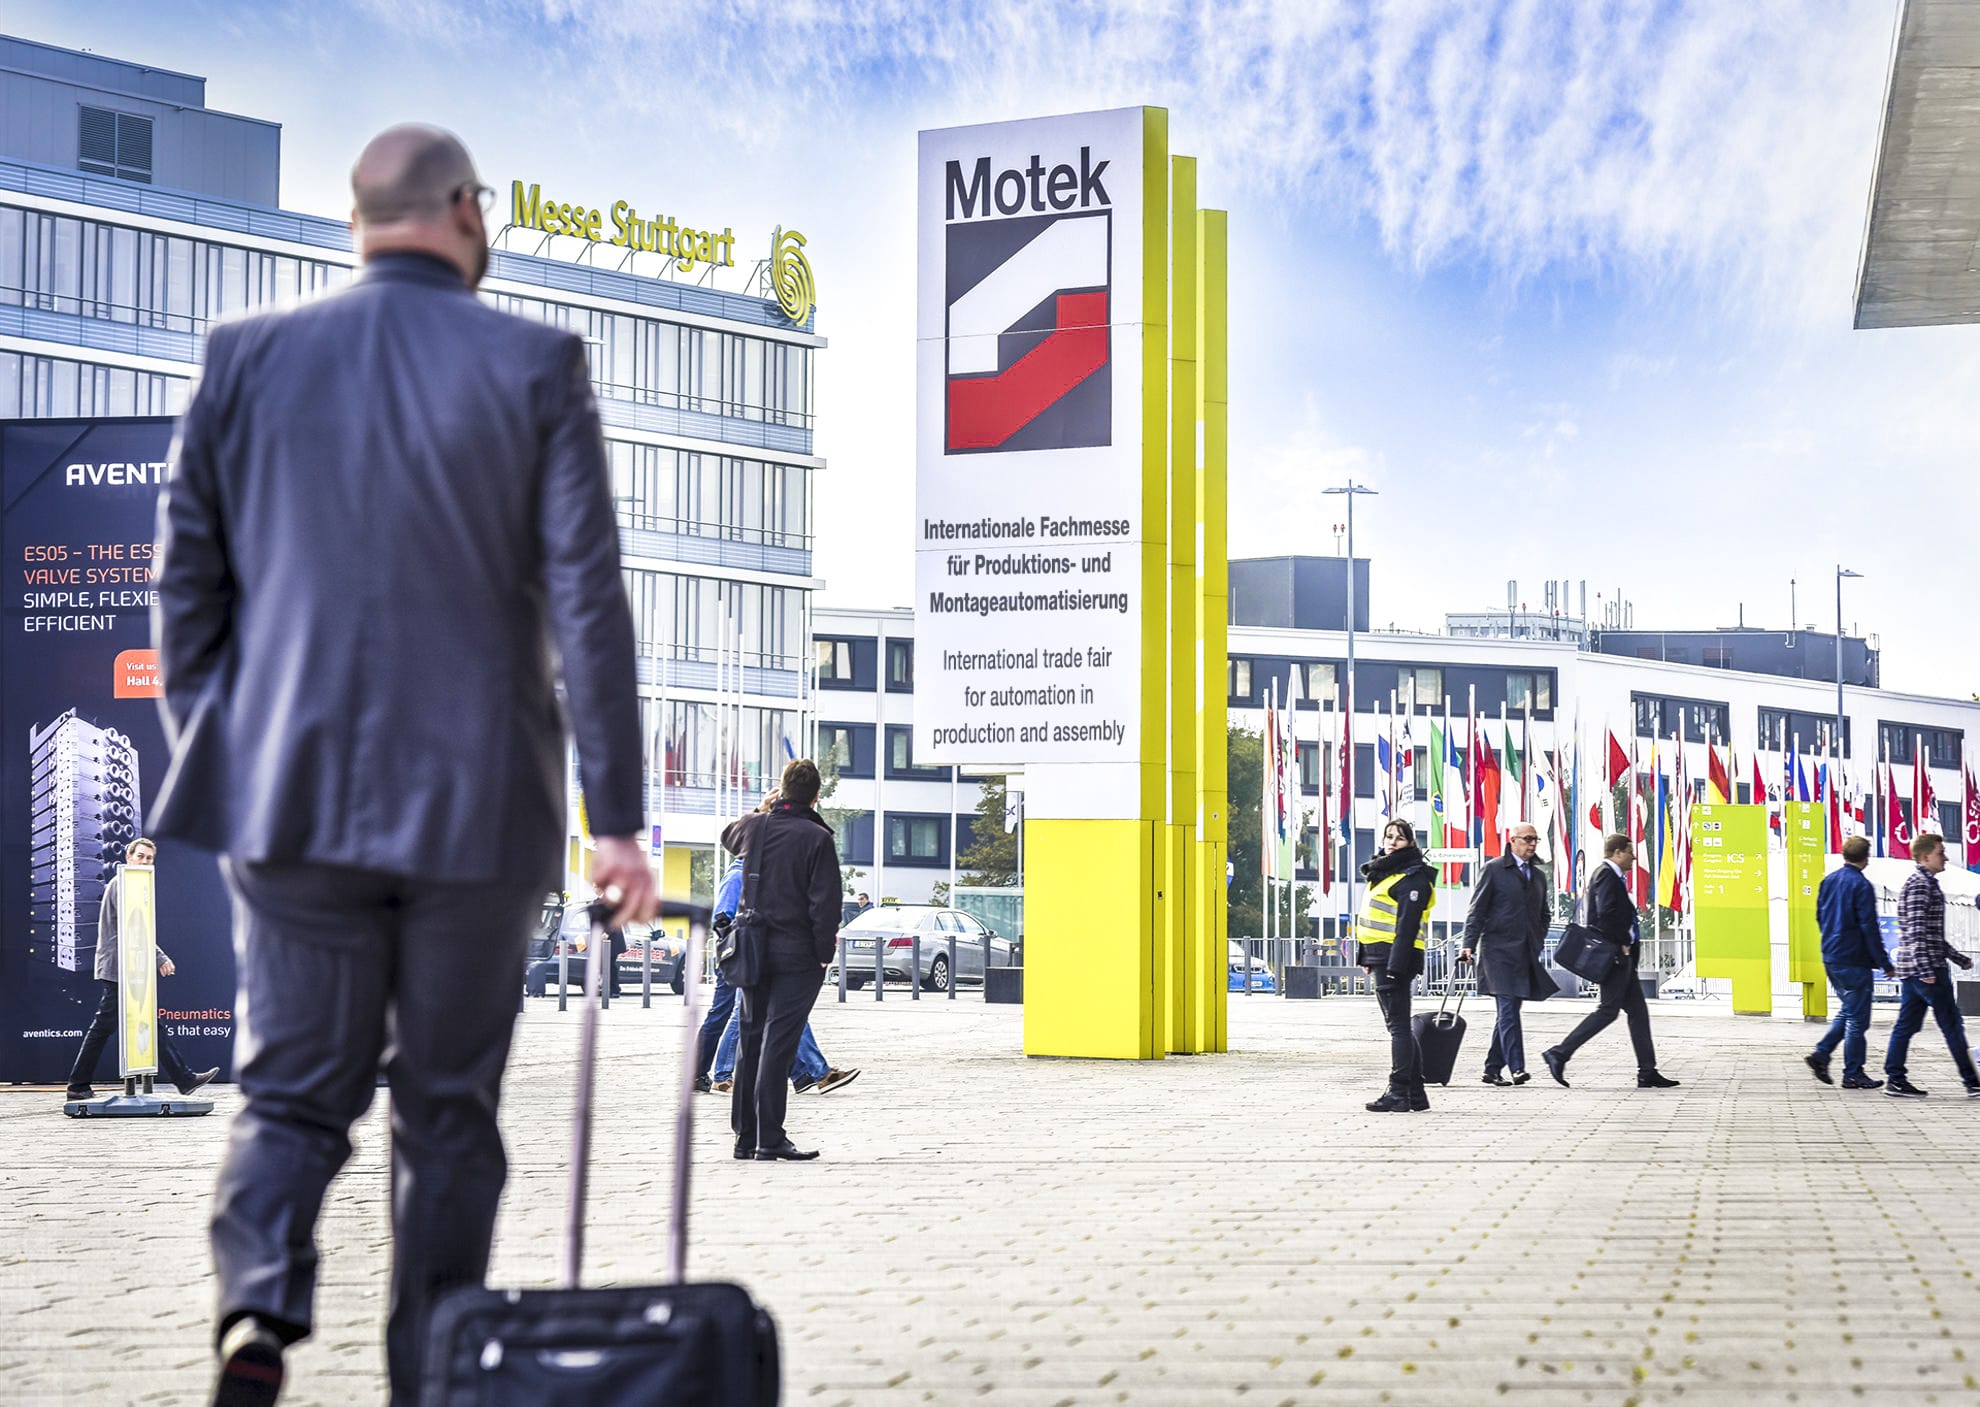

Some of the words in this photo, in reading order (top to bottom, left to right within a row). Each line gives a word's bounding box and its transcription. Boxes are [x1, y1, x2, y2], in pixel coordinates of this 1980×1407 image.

[946, 146, 1112, 221] Motek
[511, 179, 602, 240] Messe
[610, 199, 735, 272] Stuttgart
[924, 517, 1035, 540] Internationale
[1040, 516, 1130, 538] Fachmesse
[24, 545, 68, 562] ES05
[88, 543, 125, 560] THE
[947, 555, 970, 576] für
[974, 553, 1076, 575] Produktions-
[1082, 552, 1111, 573] und
[24, 568, 81, 585] VALVE
[23, 592, 95, 610] SIMPLE,
[929, 589, 1128, 616] Montageautomatisierung
[24, 614, 117, 632] EFFICIENT
[126, 662, 145, 671] Visit
[943, 648, 1038, 671] International
[1042, 647, 1082, 669] trade
[1086, 647, 1112, 667] fair
[126, 675, 150, 687] Hall
[964, 687, 986, 707] for
[990, 685, 1075, 705] automation
[1080, 684, 1094, 704] in
[933, 723, 1015, 749] production
[1020, 721, 1048, 743] and
[1053, 720, 1125, 745] assembly
[1727, 853, 1745, 864] ICS
[158, 1008, 231, 1020] Pneumatics
[23, 1028, 83, 1039] aventics.com
[177, 1025, 201, 1036] that
[203, 1027, 231, 1038] easy
